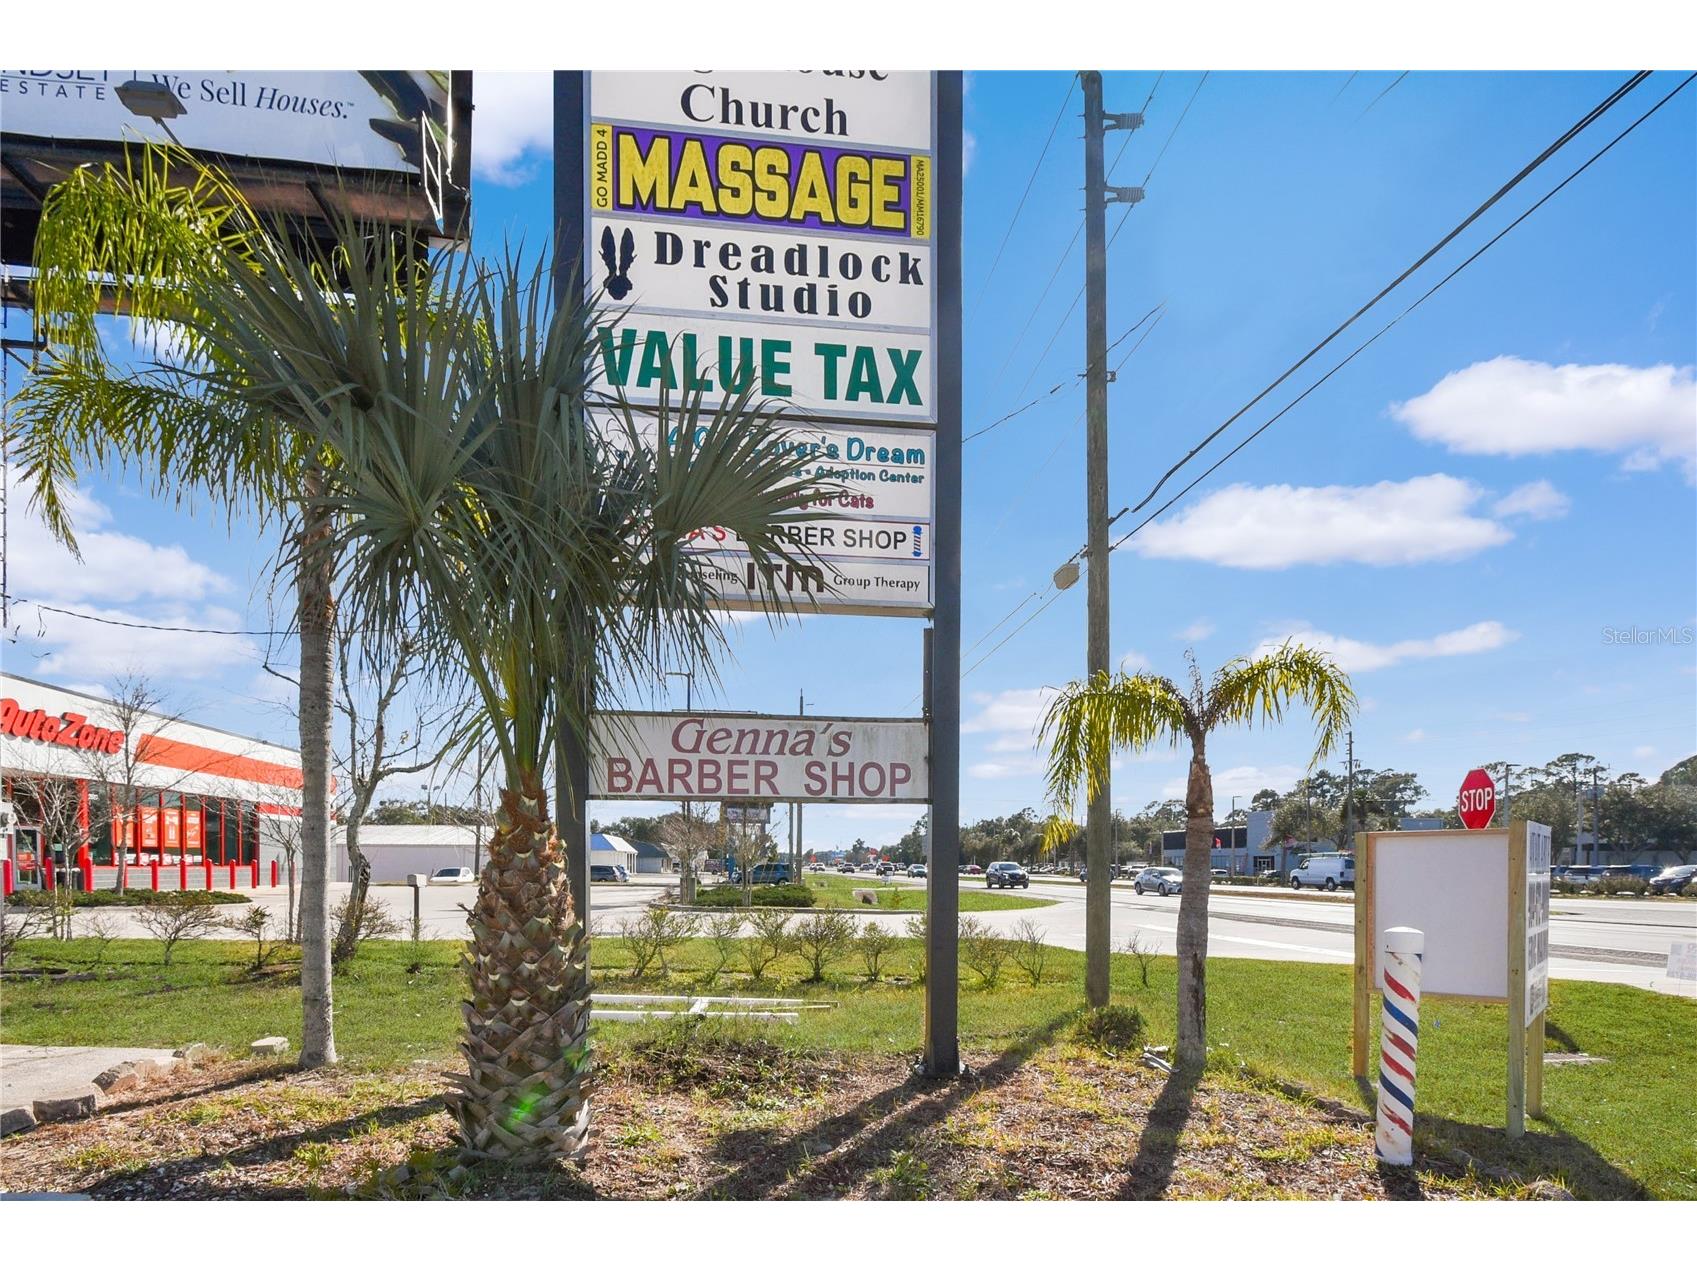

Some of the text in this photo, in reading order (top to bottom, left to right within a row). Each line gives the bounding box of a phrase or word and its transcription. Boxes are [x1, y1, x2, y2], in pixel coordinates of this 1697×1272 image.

[0, 78, 105, 100] ESTATE
[200, 79, 247, 107] Sell
[680, 84, 849, 136] Church
[596, 129, 608, 208] GO MADD 4
[617, 132, 906, 231] MASSAGE
[654, 231, 924, 286] Dreadlock
[708, 274, 872, 319] Studio
[597, 326, 924, 406] VALUE TAX
[847, 437, 925, 465] Dream
[814, 465, 876, 483] Adoption
[879, 469, 925, 484] Center
[838, 489, 874, 509] Cats
[843, 528, 907, 550] SHOP
[833, 574, 871, 589] Group
[874, 576, 921, 592] Therapy
[0, 698, 125, 754] AutoZone
[670, 718, 853, 757] Genna's
[607, 757, 912, 797] BARBER SHOP
[1461, 787, 1493, 812] STOP
